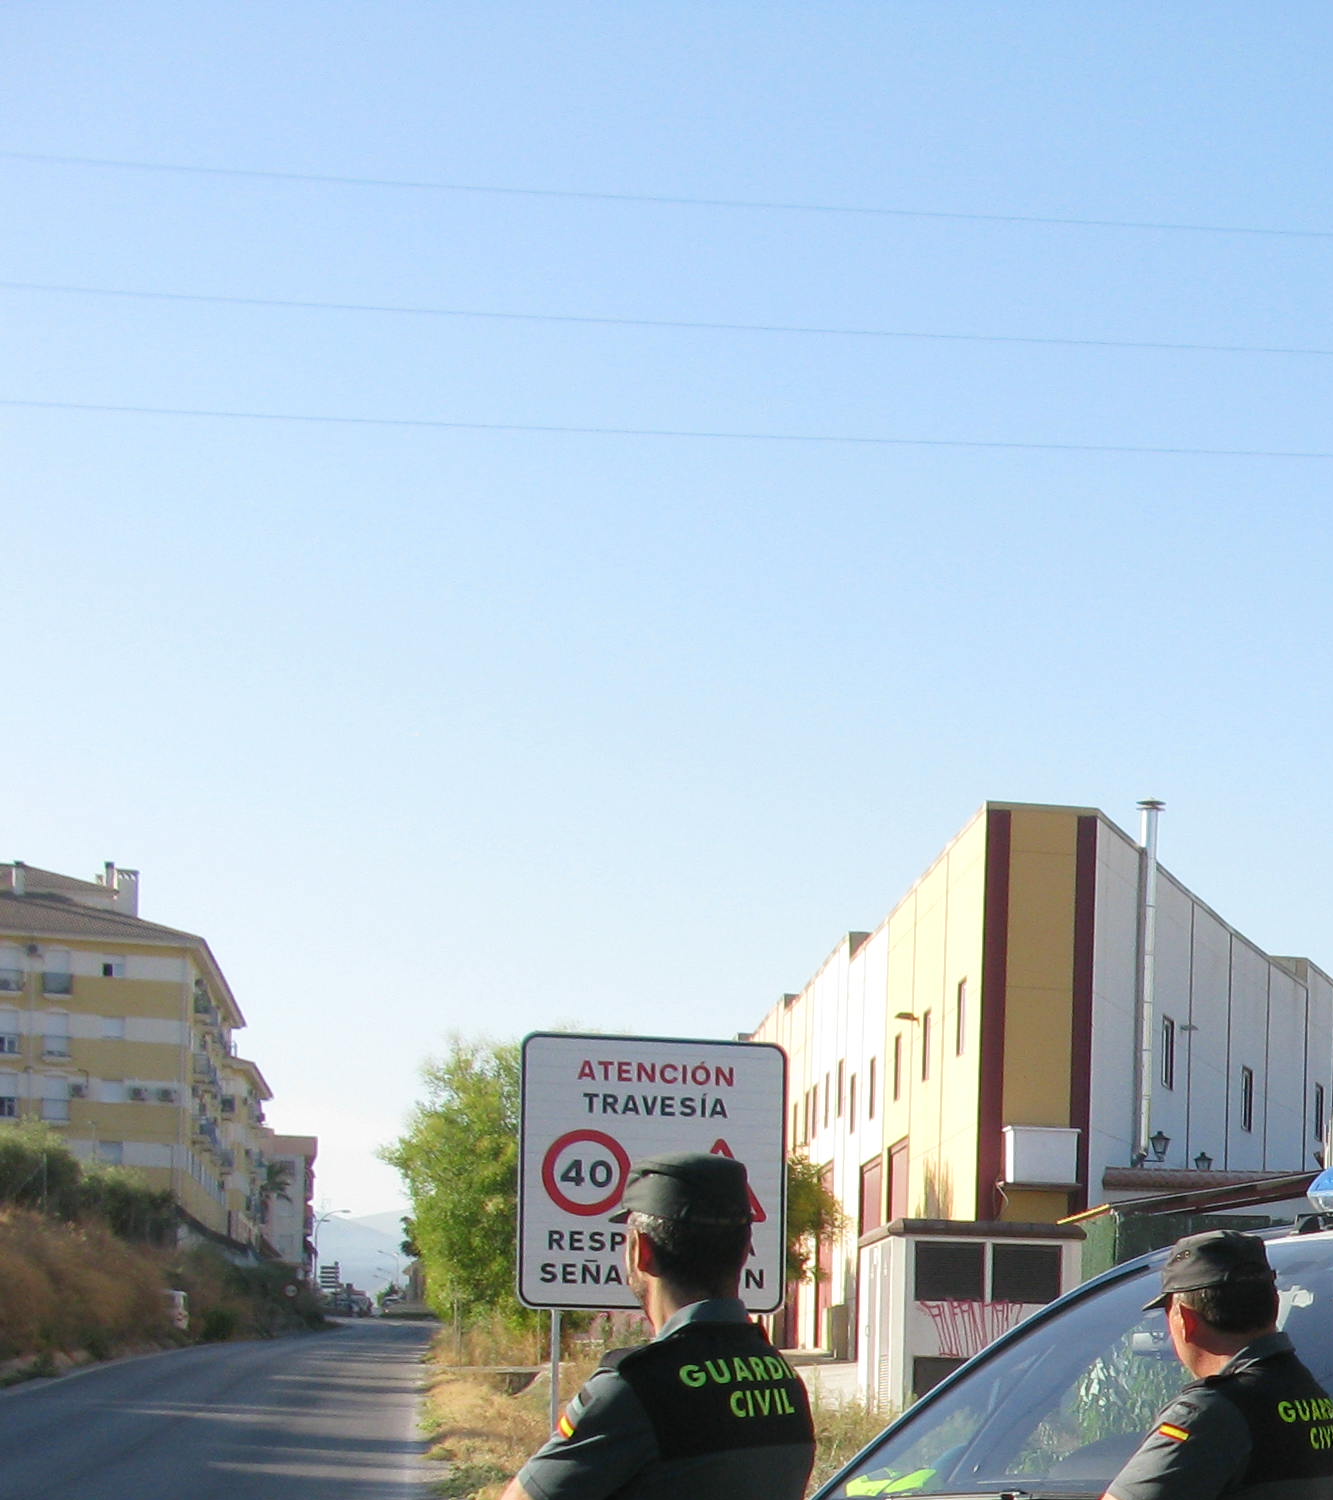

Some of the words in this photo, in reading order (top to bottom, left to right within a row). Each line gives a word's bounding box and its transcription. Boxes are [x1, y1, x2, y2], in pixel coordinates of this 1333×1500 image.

[577, 1060, 734, 1086] ATENCIÓN
[583, 1093, 728, 1118] TRAVESÍA
[560, 1159, 612, 1187] 40
[548, 1230, 626, 1251] RESP
[679, 1356, 797, 1387] GUARDI
[730, 1388, 795, 1417] CIVIL
